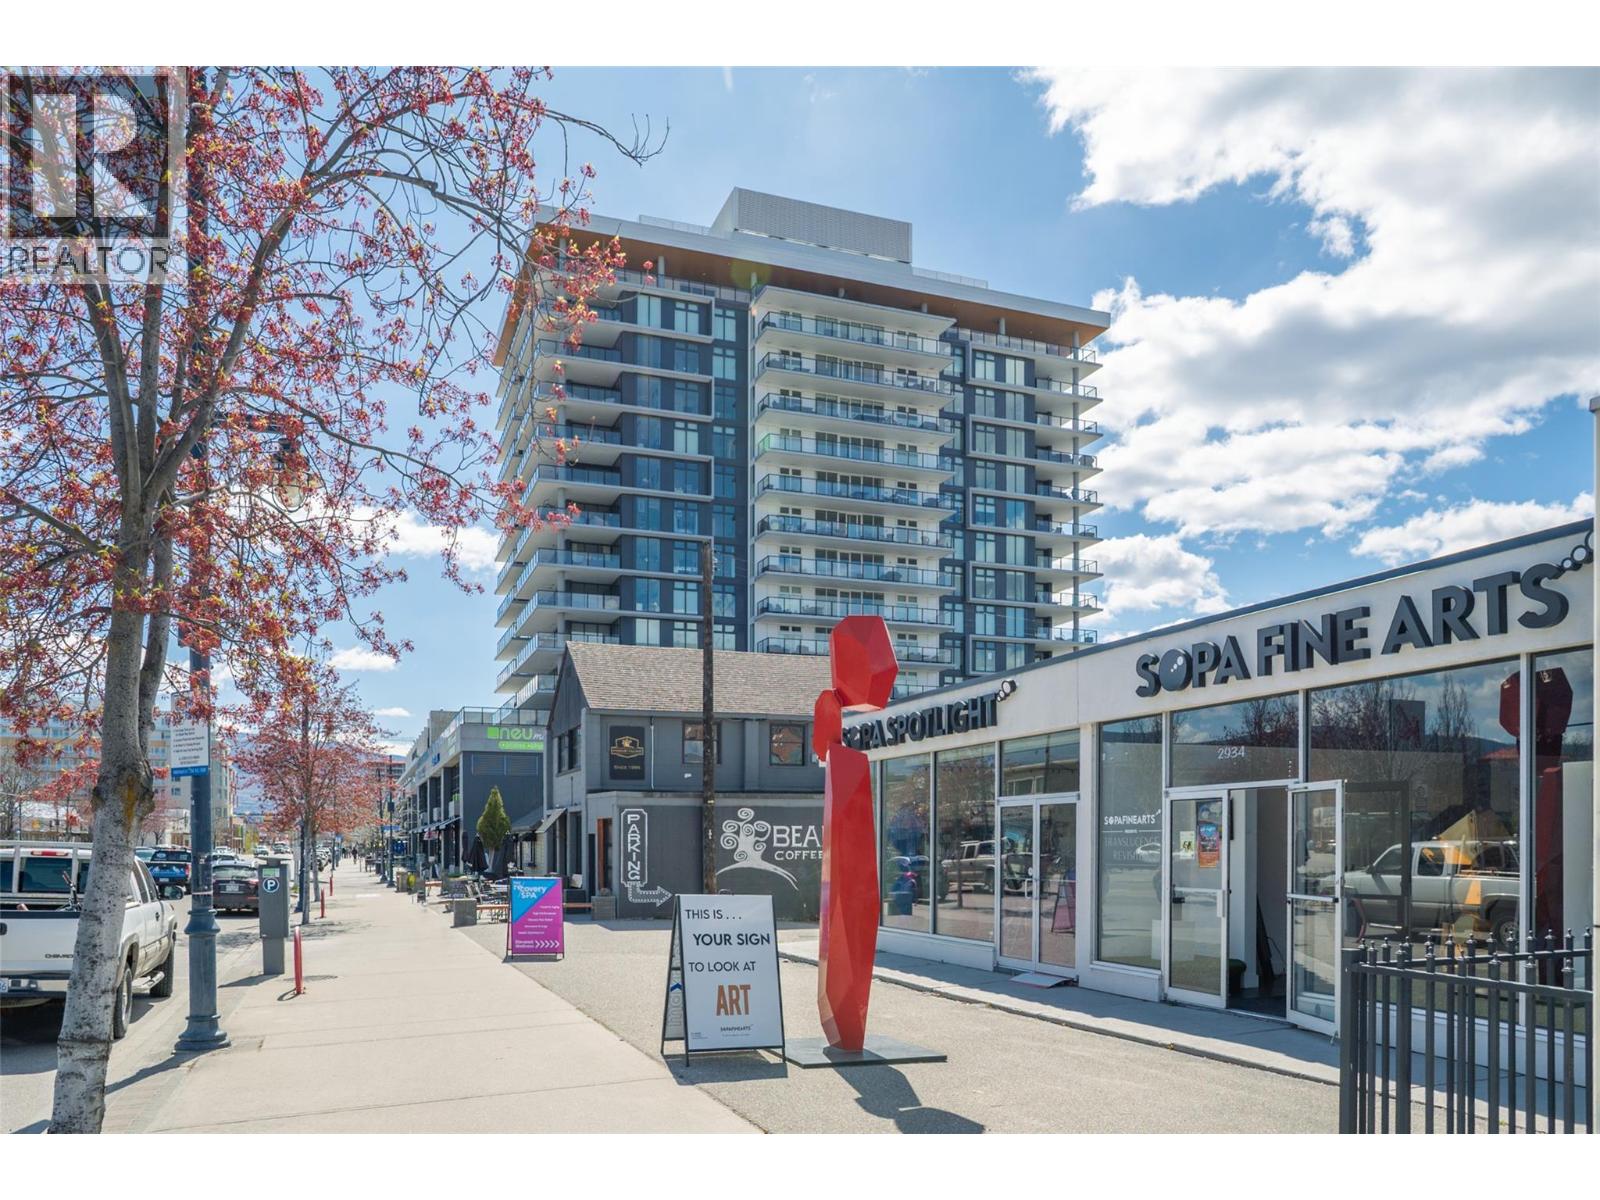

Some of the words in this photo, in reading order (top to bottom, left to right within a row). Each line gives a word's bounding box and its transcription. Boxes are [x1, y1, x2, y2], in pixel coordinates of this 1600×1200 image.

[1136, 635, 1252, 697] SOPA
[1257, 606, 1371, 676] FINE
[1382, 562, 1569, 655] ARTS
[887, 692, 997, 745] SPOTLIGHT
[500, 727, 533, 740] neu
[1218, 746, 1245, 759] 2934
[773, 825, 824, 847] BEA
[627, 814, 641, 880] PARKING
[267, 880, 275, 890] P
[685, 909, 710, 919] THIS
[713, 909, 723, 919] IS
[693, 933, 733, 946] YOUR
[737, 933, 770, 946] SIGN
[689, 962, 704, 973] TO
[708, 961, 740, 972] LOOK
[743, 961, 757, 971] AT
[716, 984, 752, 1016] ART
